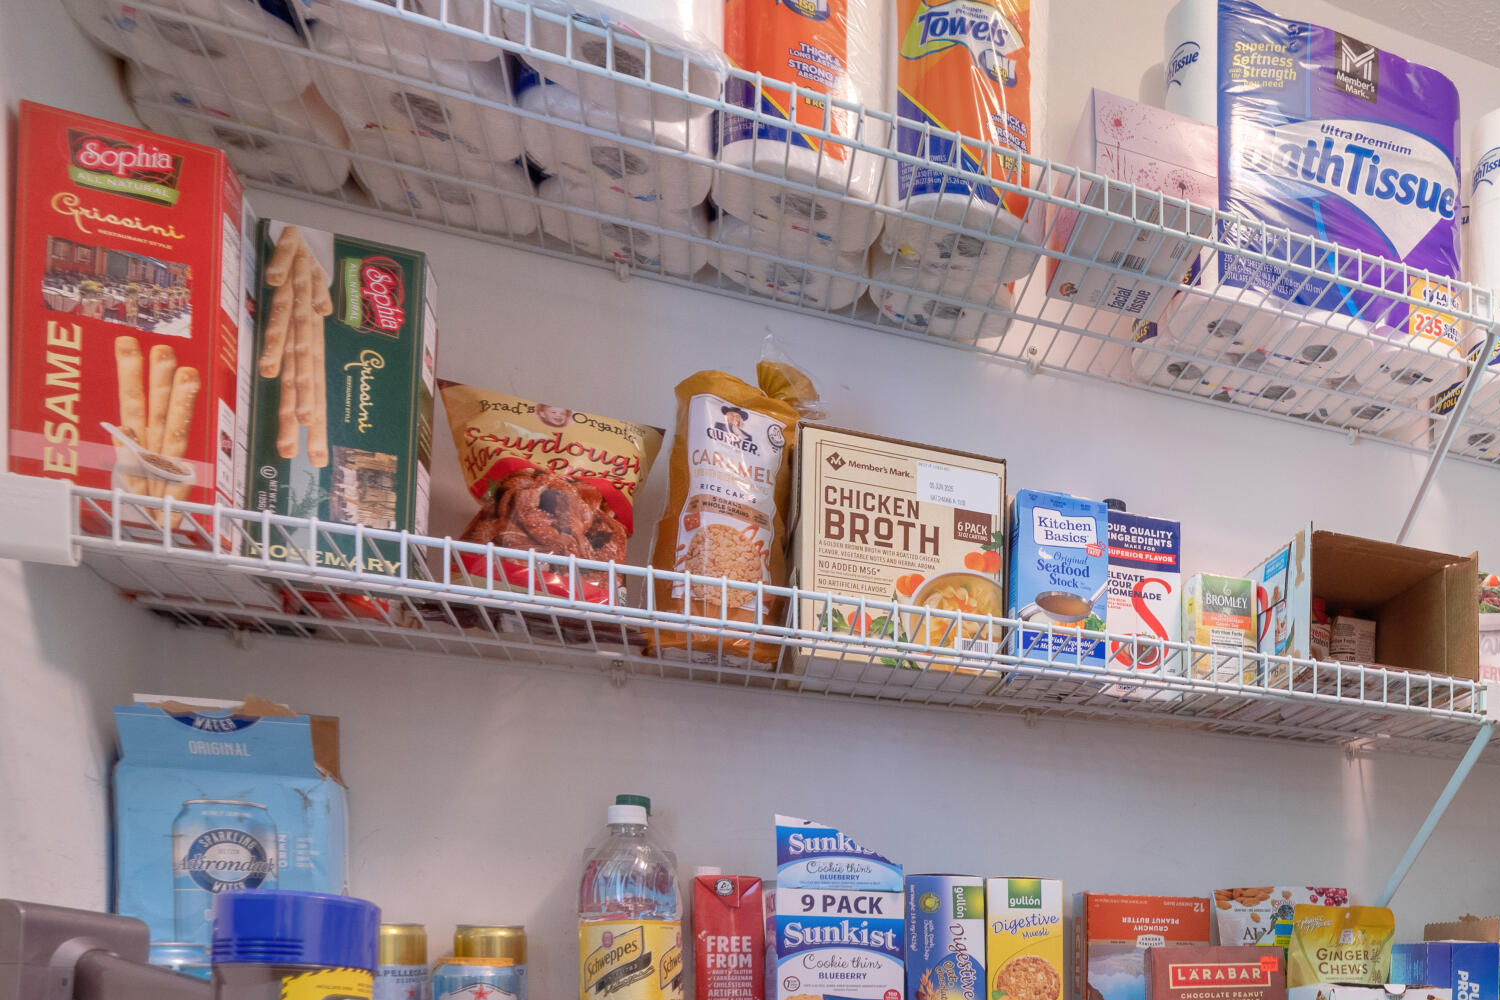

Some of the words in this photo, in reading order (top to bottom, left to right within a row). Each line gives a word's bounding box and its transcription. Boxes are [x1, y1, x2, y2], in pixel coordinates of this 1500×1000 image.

[918, 11, 1009, 46] Towels
[1234, 41, 1287, 53] Superior
[1233, 53, 1293, 68] Softness
[1242, 66, 1297, 81] Strength
[1336, 71, 1375, 94] Member's
[1321, 123, 1353, 141] Ultra
[1354, 132, 1412, 156] Premium
[79, 141, 173, 176] Sophia
[77, 171, 104, 185] ALL
[107, 178, 171, 198] NATURAL
[51, 191, 186, 240] Grissini
[365, 264, 406, 331] Sophia
[1415, 313, 1443, 337] 235
[43, 320, 84, 482] ESAME
[480, 399, 535, 415] Brad's
[692, 449, 773, 486] CARAMEL
[848, 459, 888, 475] Member's
[825, 485, 920, 520] CHICKEN
[825, 508, 940, 556] BROTH
[957, 521, 963, 532] 6
[965, 523, 988, 536] PACK
[1037, 516, 1092, 532] Kitchen
[1044, 529, 1088, 543] Basics
[1108, 532, 1173, 548] INGREDIENTS
[1129, 527, 1173, 540] QUALITY
[1053, 551, 1088, 568] Original
[1036, 558, 1090, 579] Seafood
[818, 578, 827, 586] NO
[828, 579, 860, 590] ARTIFICIAL
[860, 585, 887, 594] FLAVORS
[1049, 574, 1079, 589] Stock
[1108, 587, 1162, 601] HOMEMADE
[1205, 593, 1248, 610] BROMLEY
[193, 717, 236, 733] WATER
[188, 740, 251, 757] ORIGINAL
[198, 831, 257, 850] SPARKLING
[806, 861, 844, 875] Cookie
[846, 860, 873, 874] thins
[801, 895, 815, 913] 9
[822, 895, 883, 914] PACK
[954, 887, 966, 919] gullón
[1010, 896, 1041, 908] gullón
[992, 912, 1060, 935] Digestive
[1122, 916, 1150, 924] BUTTER
[1151, 917, 1180, 925] PEANUT
[706, 935, 752, 953] FREE
[784, 921, 899, 951] Sunkist
[586, 938, 638, 980] Schweppes
[706, 953, 752, 969] FROM
[802, 952, 848, 970] Cookie
[850, 952, 883, 970] thins
[949, 923, 976, 1000] Digestive
[1316, 948, 1369, 961] GINGER
[818, 972, 867, 980] BLUEBERRY
[1318, 962, 1368, 975] CHEWS
[707, 989, 752, 997] ARTIFICIAL
[1232, 991, 1264, 999] PEANUT
